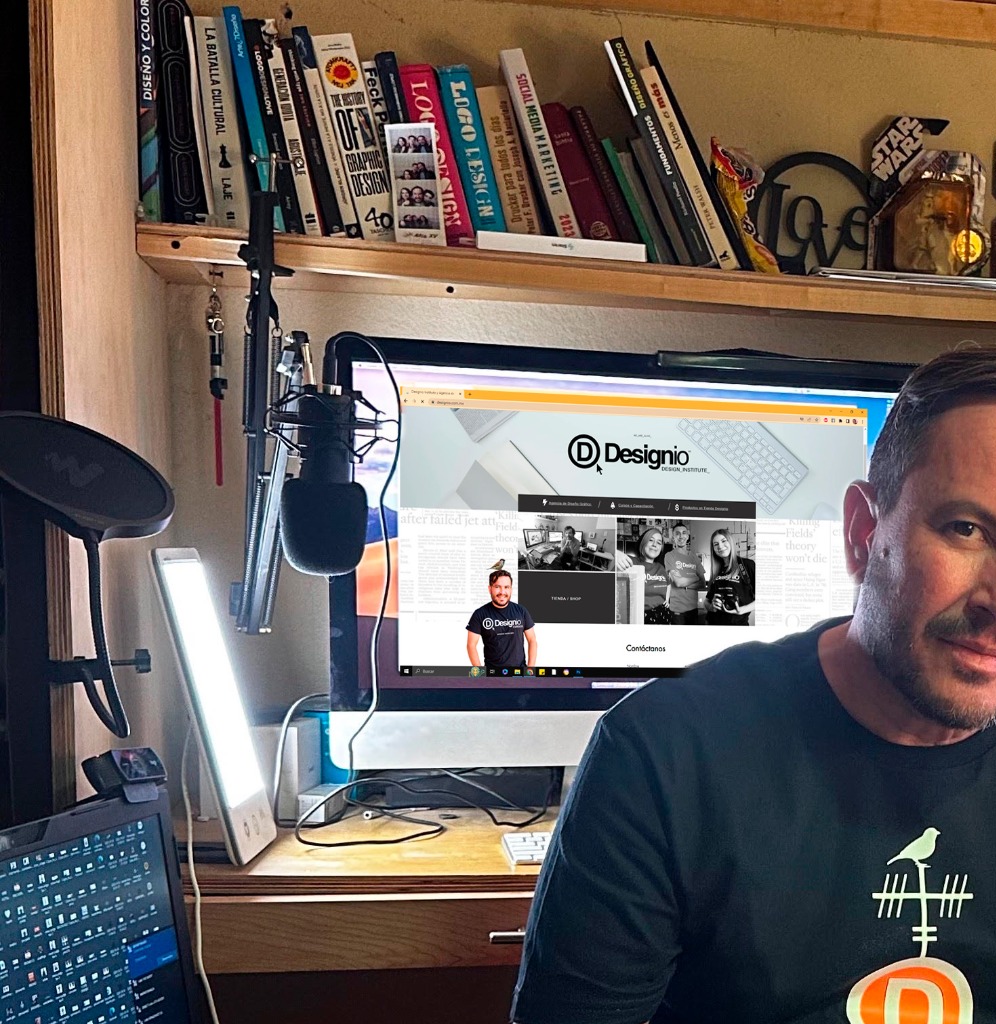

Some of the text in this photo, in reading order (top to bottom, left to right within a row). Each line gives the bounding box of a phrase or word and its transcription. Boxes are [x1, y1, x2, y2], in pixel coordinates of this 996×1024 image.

[140, 0, 152, 100] DISEÑO Y COLOR
[205, 27, 226, 135] LA BATALLA CULTURAL
[364, 68, 384, 107] Feck
[615, 42, 646, 109] DISEÑO GRÁFICO
[330, 94, 342, 107] THE
[335, 108, 359, 151] OF
[650, 82, 683, 150] Menos es más
[515, 73, 563, 195] SOCIAL MEDIA MARKETING
[645, 115, 672, 176] FUNDAMENTOS
[872, 117, 919, 171] STAR
[346, 150, 384, 173] GRAPHIC
[450, 81, 476, 142] LOGO
[464, 148, 494, 217] DESIGN
[511, 146, 522, 170] Joseph
[872, 124, 923, 182] WARS
[490, 116, 522, 223] Drucker para todos los días
[221, 178, 233, 200] LAJE
[350, 170, 390, 198] DESIGN
[518, 183, 530, 206] Drucker
[364, 207, 394, 229] 40
[559, 214, 576, 238] 2023
[704, 210, 716, 230] PETER
[604, 442, 690, 470] Designio
[400, 513, 428, 525] after
[430, 513, 462, 525] failed
[465, 515, 480, 528] jet
[495, 522, 518, 531] Field
[785, 540, 816, 552] theory
[812, 553, 828, 563] die
[495, 619, 522, 629] Designio
